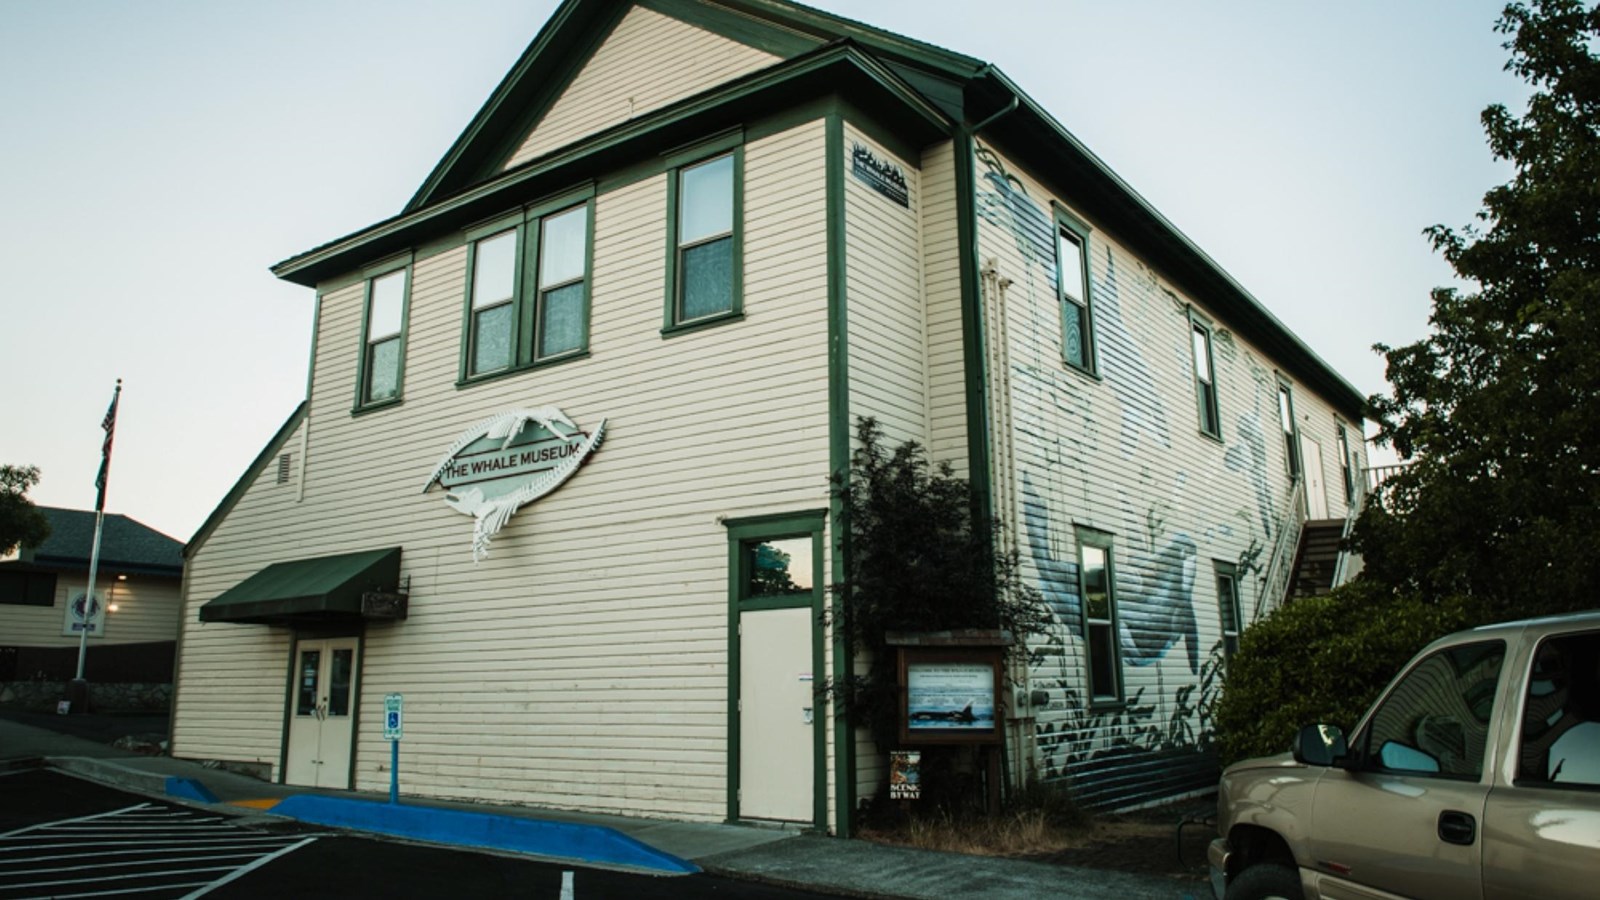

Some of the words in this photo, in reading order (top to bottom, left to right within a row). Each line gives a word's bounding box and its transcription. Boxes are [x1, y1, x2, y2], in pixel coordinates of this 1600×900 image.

[446, 463, 469, 479] THE
[471, 454, 518, 475] WHALE
[520, 443, 580, 465] MUSEUM
[890, 783, 921, 791] SCENIC
[890, 791, 921, 800] BYWAY
